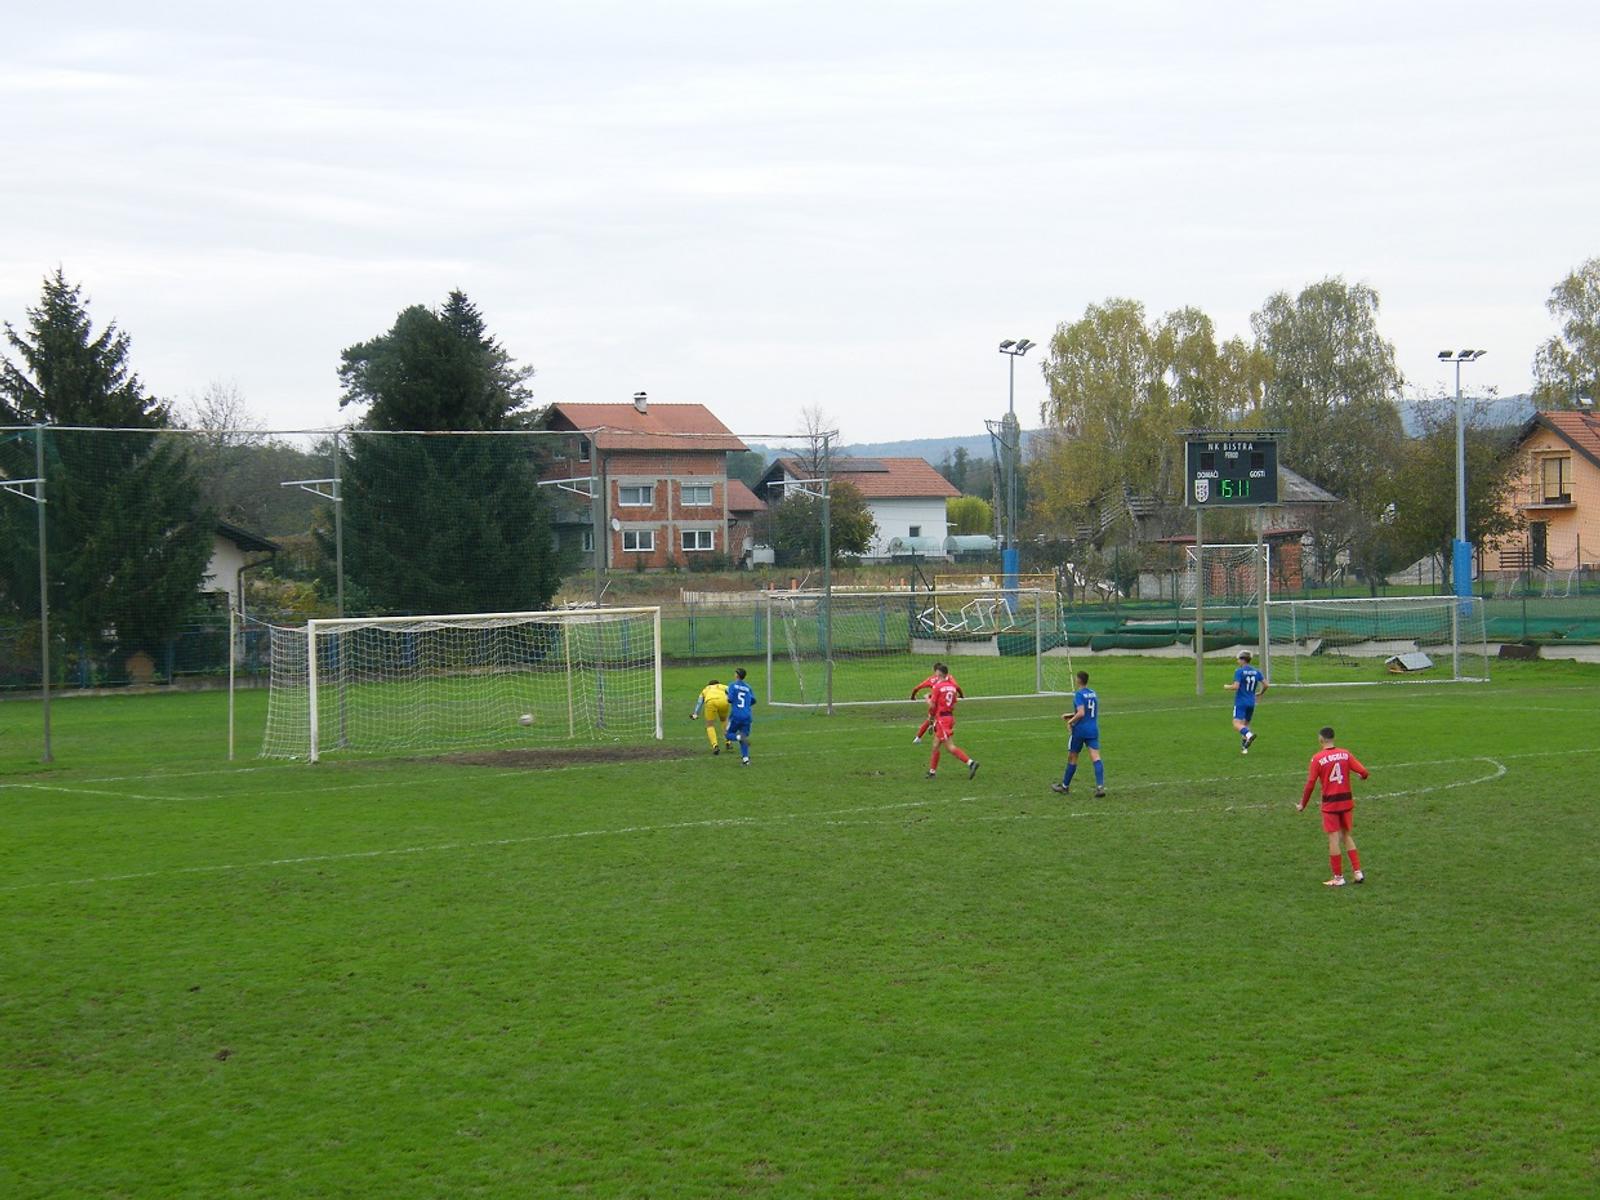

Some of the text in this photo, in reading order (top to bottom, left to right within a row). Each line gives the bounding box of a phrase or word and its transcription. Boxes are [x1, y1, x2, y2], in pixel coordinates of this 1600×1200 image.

[1249, 470, 1265, 478] GOSTI
[1246, 676, 1255, 691] 11
[737, 692, 745, 708] 5
[945, 691, 953, 706] 9
[1088, 699, 1095, 717] 4
[1329, 762, 1344, 784] 4
